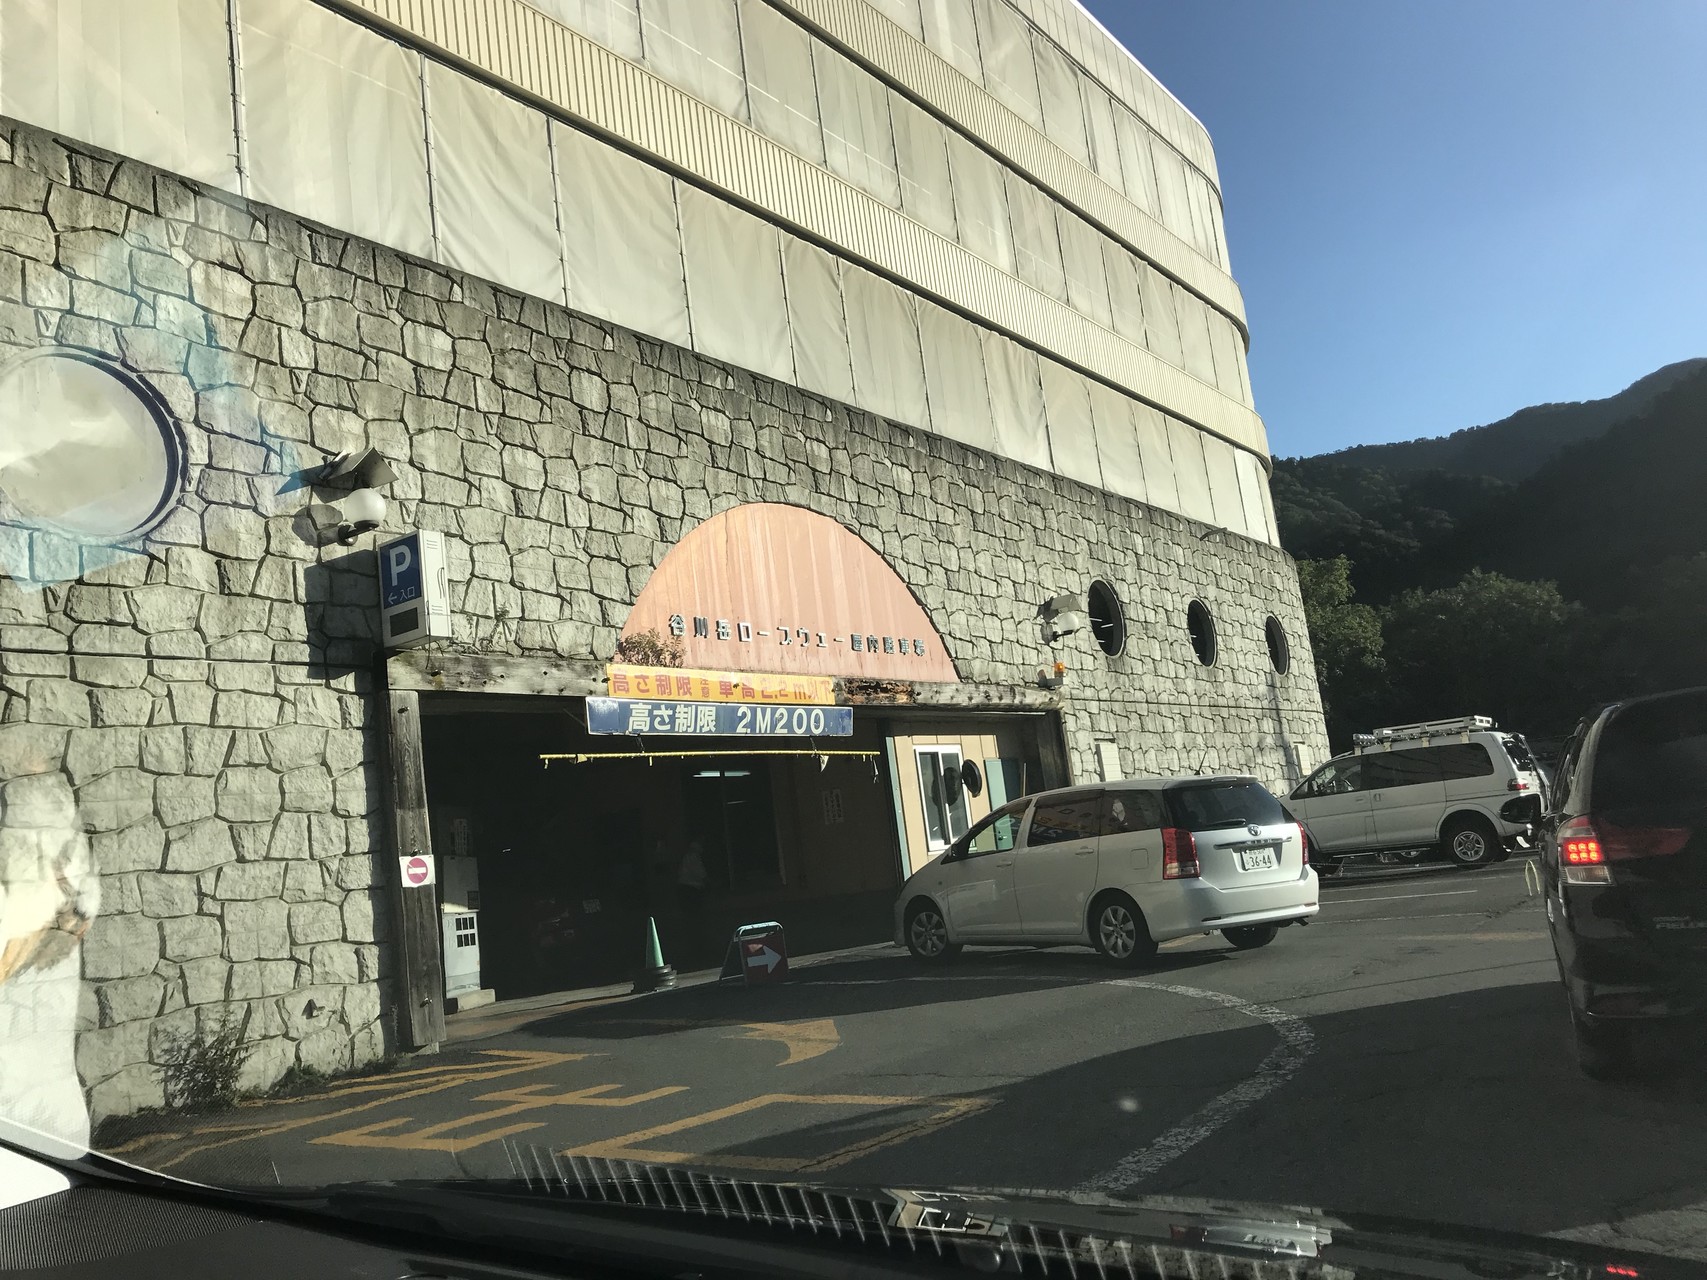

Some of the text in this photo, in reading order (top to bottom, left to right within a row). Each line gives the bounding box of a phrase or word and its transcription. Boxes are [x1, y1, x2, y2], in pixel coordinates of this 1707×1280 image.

[389, 544, 412, 587] P
[399, 586, 416, 601] 入口
[612, 669, 693, 697] 高さ制限
[628, 702, 826, 735] 高さ制限 2M200
